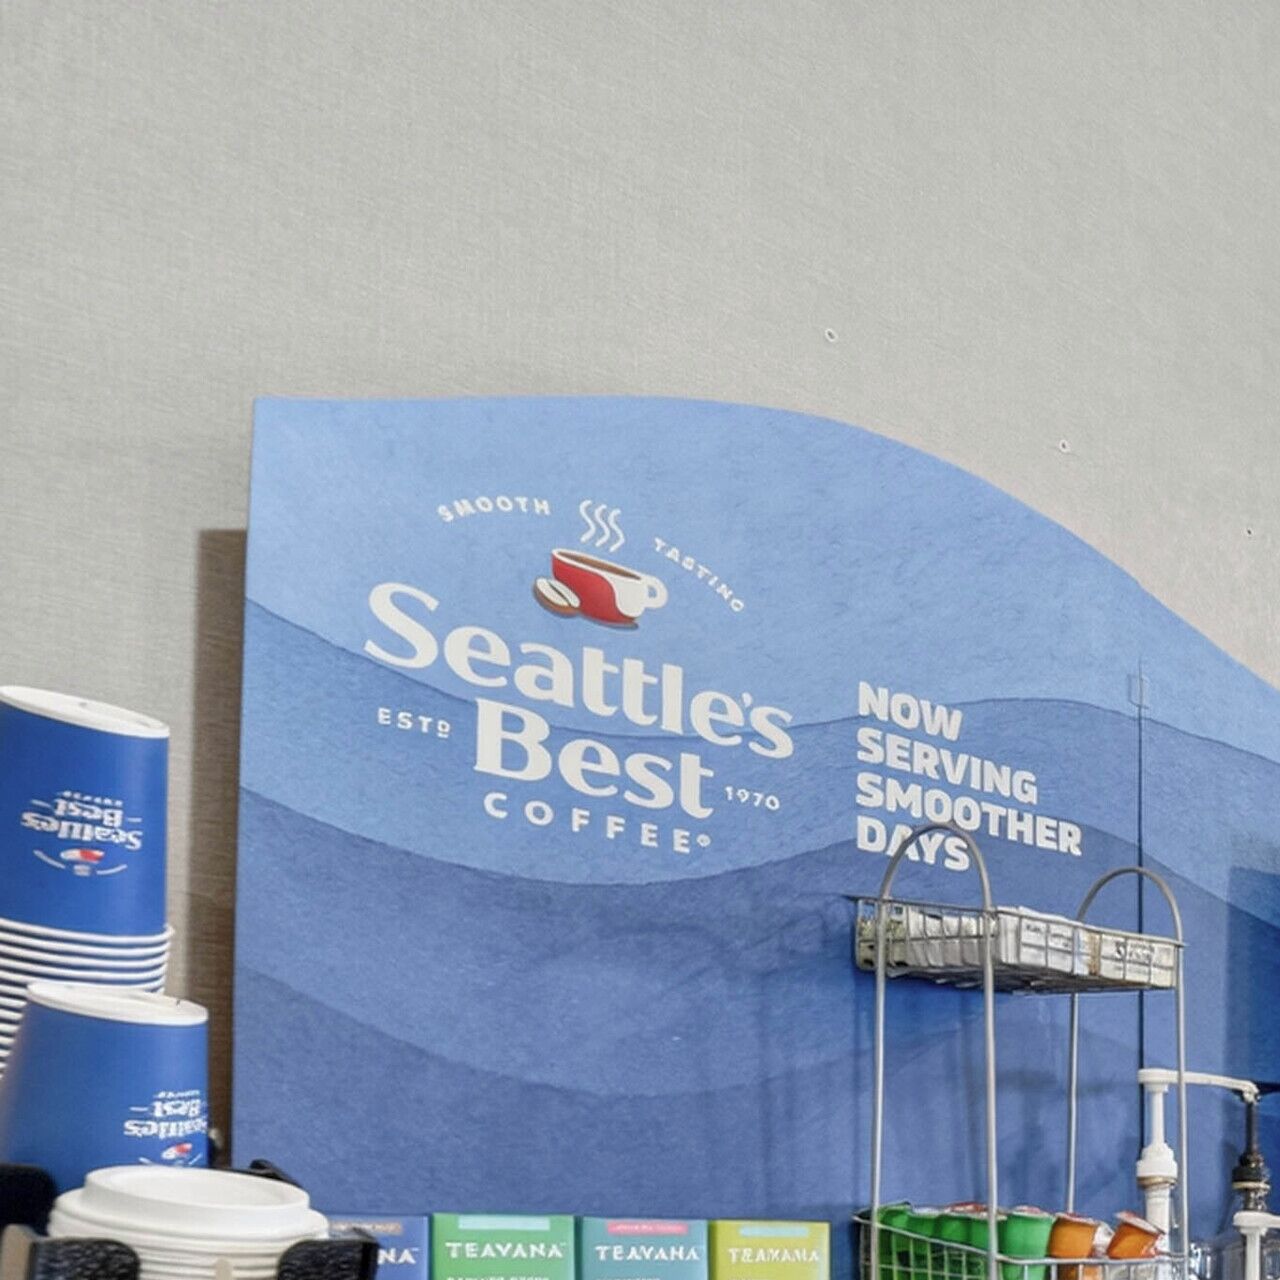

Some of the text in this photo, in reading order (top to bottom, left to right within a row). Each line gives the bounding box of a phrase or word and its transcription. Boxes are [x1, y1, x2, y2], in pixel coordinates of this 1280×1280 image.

[437, 496, 745, 612] SMOOTH TASTING
[363, 582, 795, 760] Seattle's
[857, 681, 964, 742] NOW
[473, 697, 714, 820] Best
[724, 785, 781, 812] 1970
[856, 727, 1039, 806] SERVING
[855, 772, 1083, 857] SMOOTHER
[856, 815, 971, 872] DAYS
[445, 1241, 565, 1260] TEAVANA
[596, 1244, 700, 1262] TEAVANA
